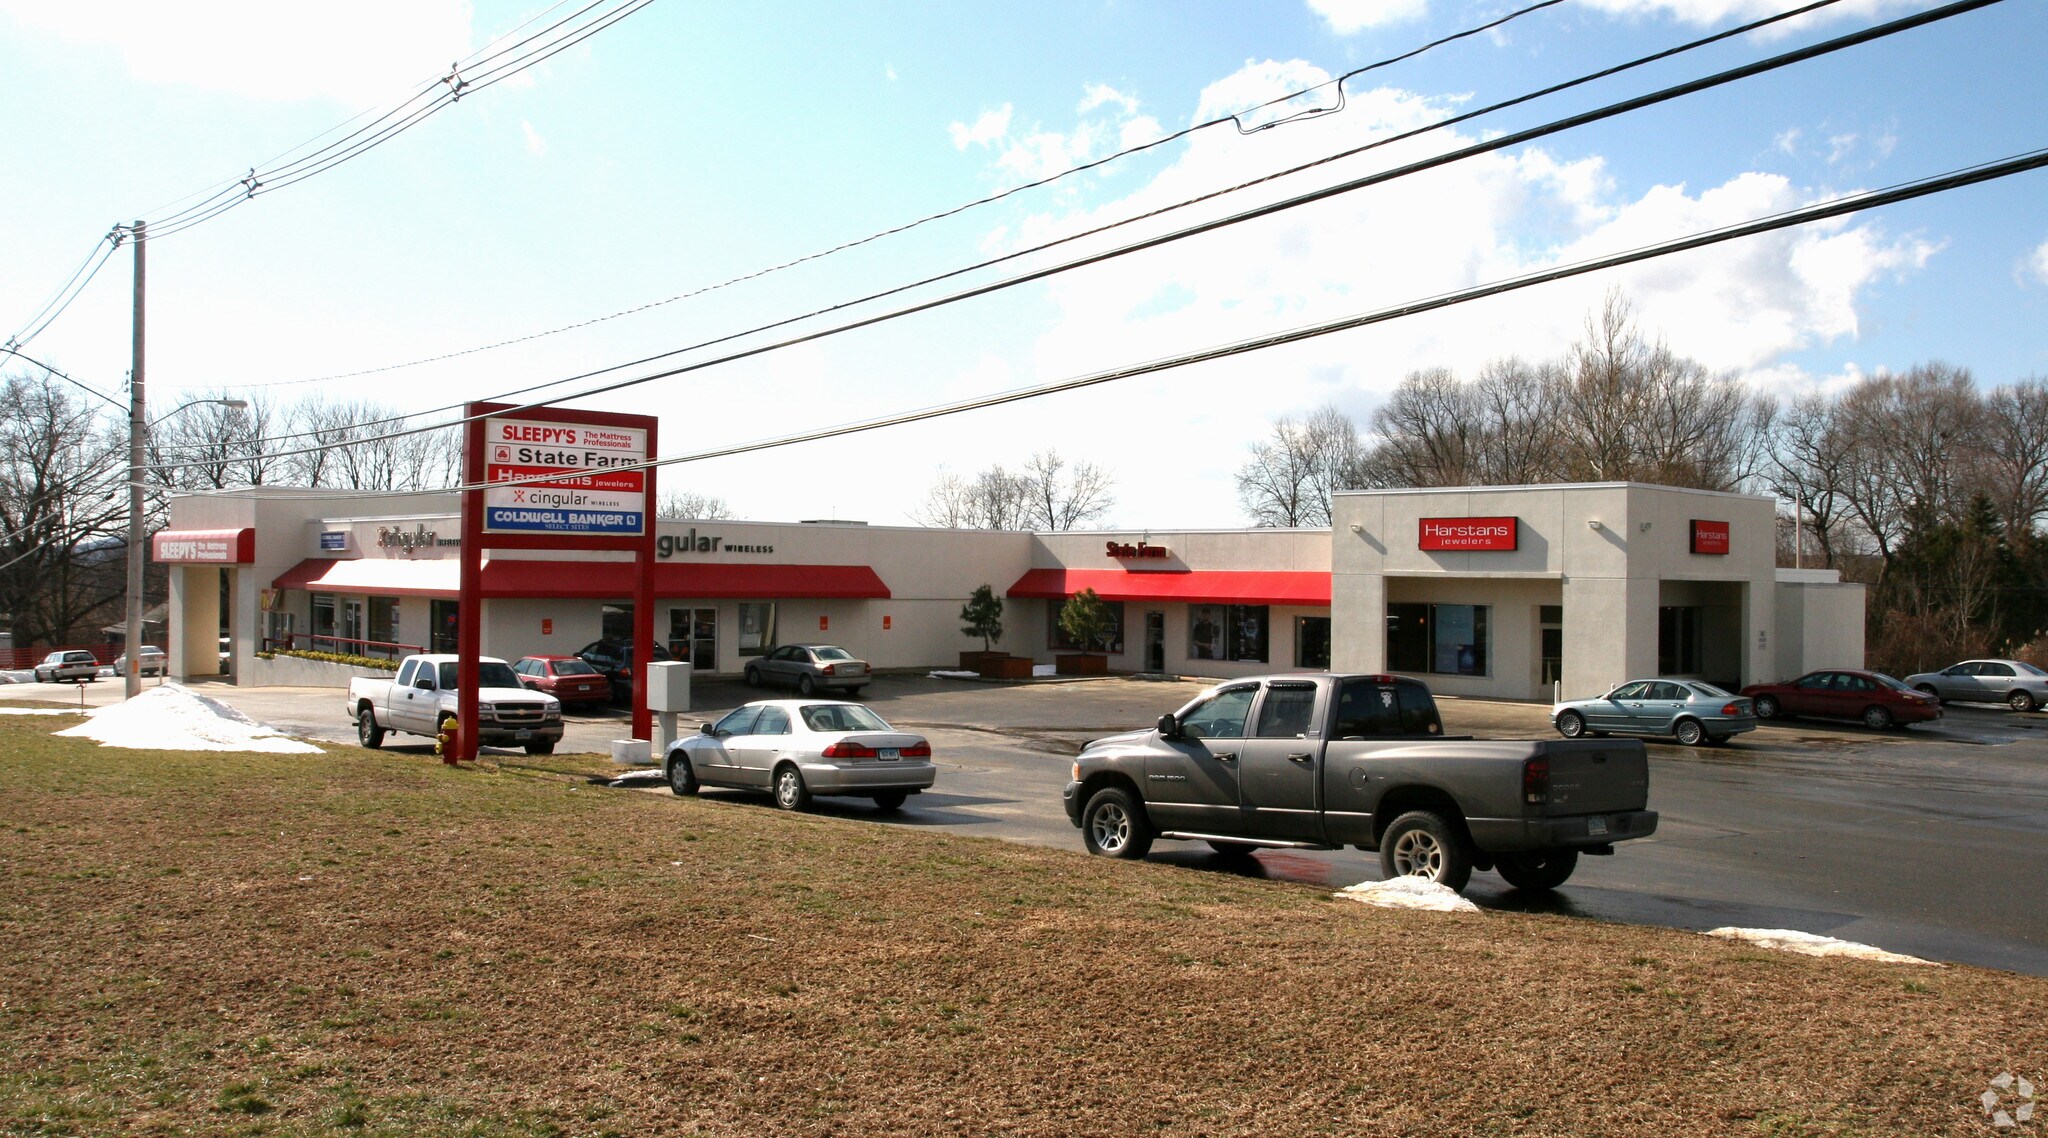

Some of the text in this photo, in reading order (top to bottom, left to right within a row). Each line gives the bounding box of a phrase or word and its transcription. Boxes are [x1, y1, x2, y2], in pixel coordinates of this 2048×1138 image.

[502, 425, 576, 444] SLEEPY'S
[584, 431, 632, 441] The Mattress
[583, 438, 632, 448] Professionals
[518, 448, 638, 469] State Farm
[595, 480, 634, 488] jewelers
[530, 490, 588, 508] cingular
[494, 511, 565, 524] COLDWELL
[569, 513, 623, 526] BANKER
[1425, 524, 1508, 536] Harstans
[1696, 530, 1728, 540] Harstans
[1441, 538, 1491, 546] jewelers
[160, 542, 197, 559] SLEEPY'S
[724, 545, 774, 553] WIRELESS
